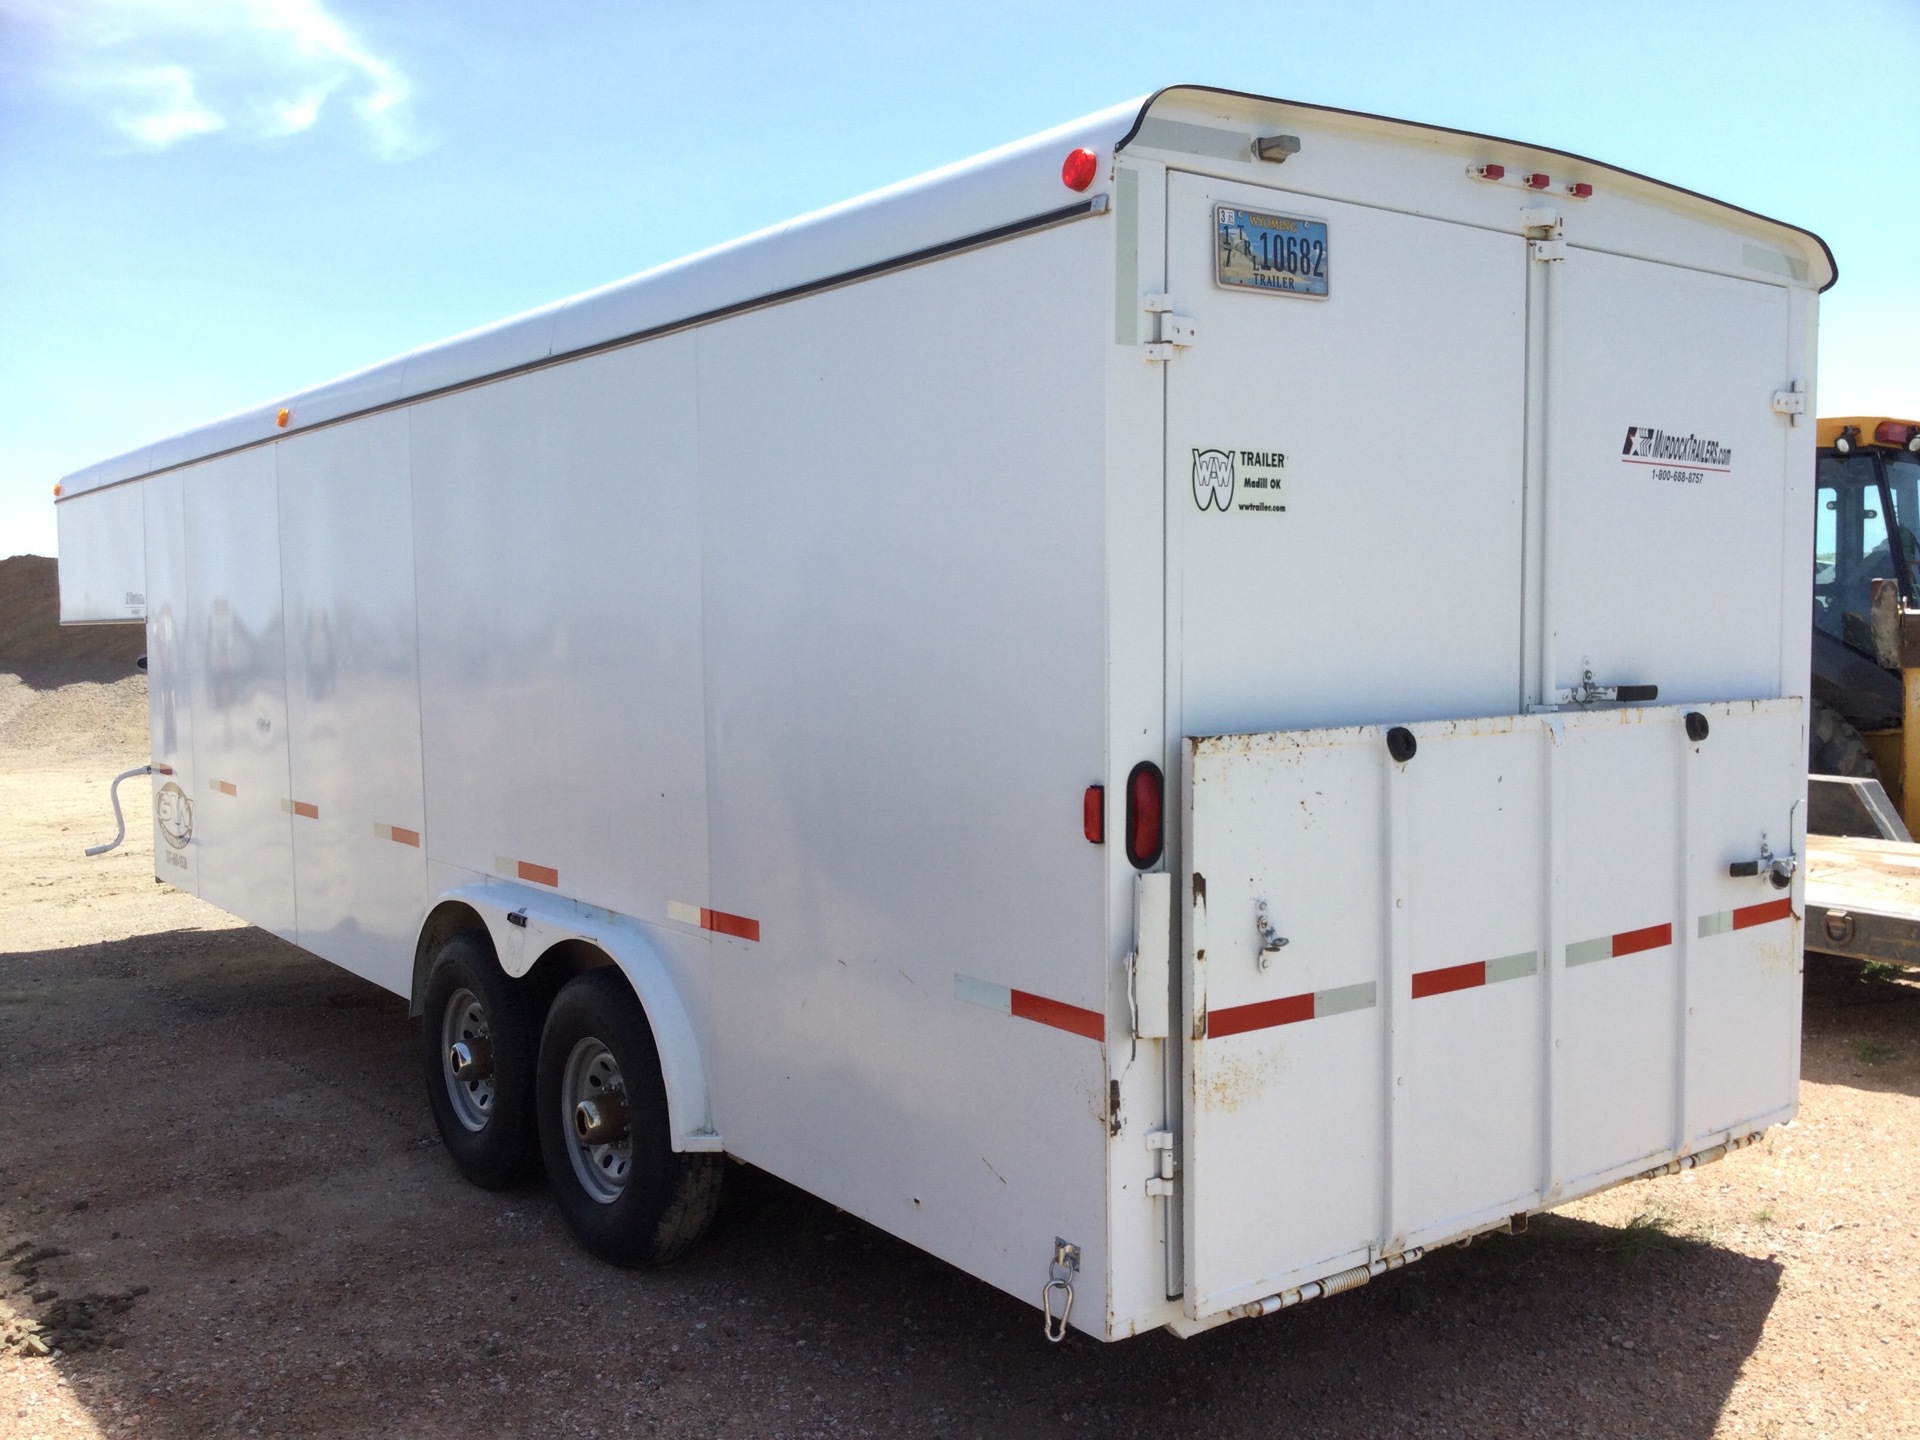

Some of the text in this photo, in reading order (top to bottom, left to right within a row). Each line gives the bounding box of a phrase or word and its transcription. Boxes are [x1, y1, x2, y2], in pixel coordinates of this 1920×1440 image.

[1250, 216, 1298, 232] WYOMING
[1260, 232, 1324, 278] 10682
[1253, 273, 1295, 290] TRAILER
[1240, 451, 1285, 468] TRAILER
[1244, 477, 1282, 489] Madill OK
[1238, 502, 1286, 512] wwtrailer.com
